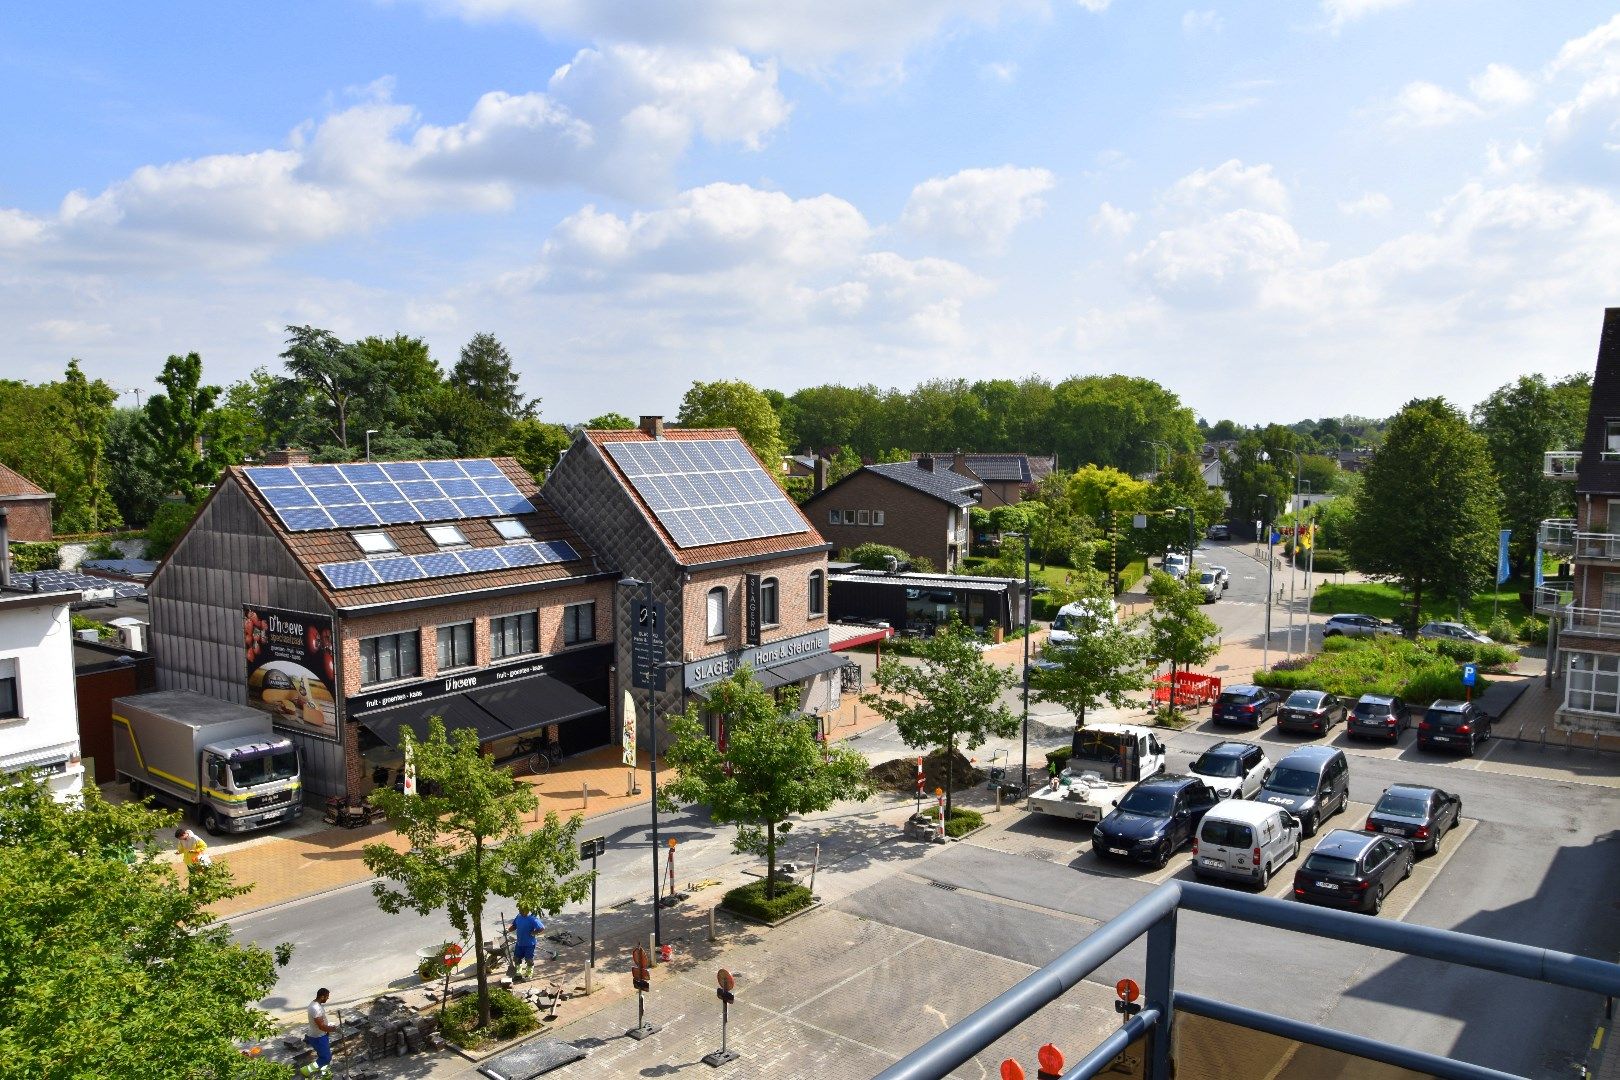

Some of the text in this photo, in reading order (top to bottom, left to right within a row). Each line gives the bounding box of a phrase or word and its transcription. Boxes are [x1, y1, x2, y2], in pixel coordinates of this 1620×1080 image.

[755, 637, 823, 666] Hans & Stefanie
[1465, 666, 1474, 678] P
[366, 699, 379, 708] fruit
[382, 693, 406, 706] groenten
